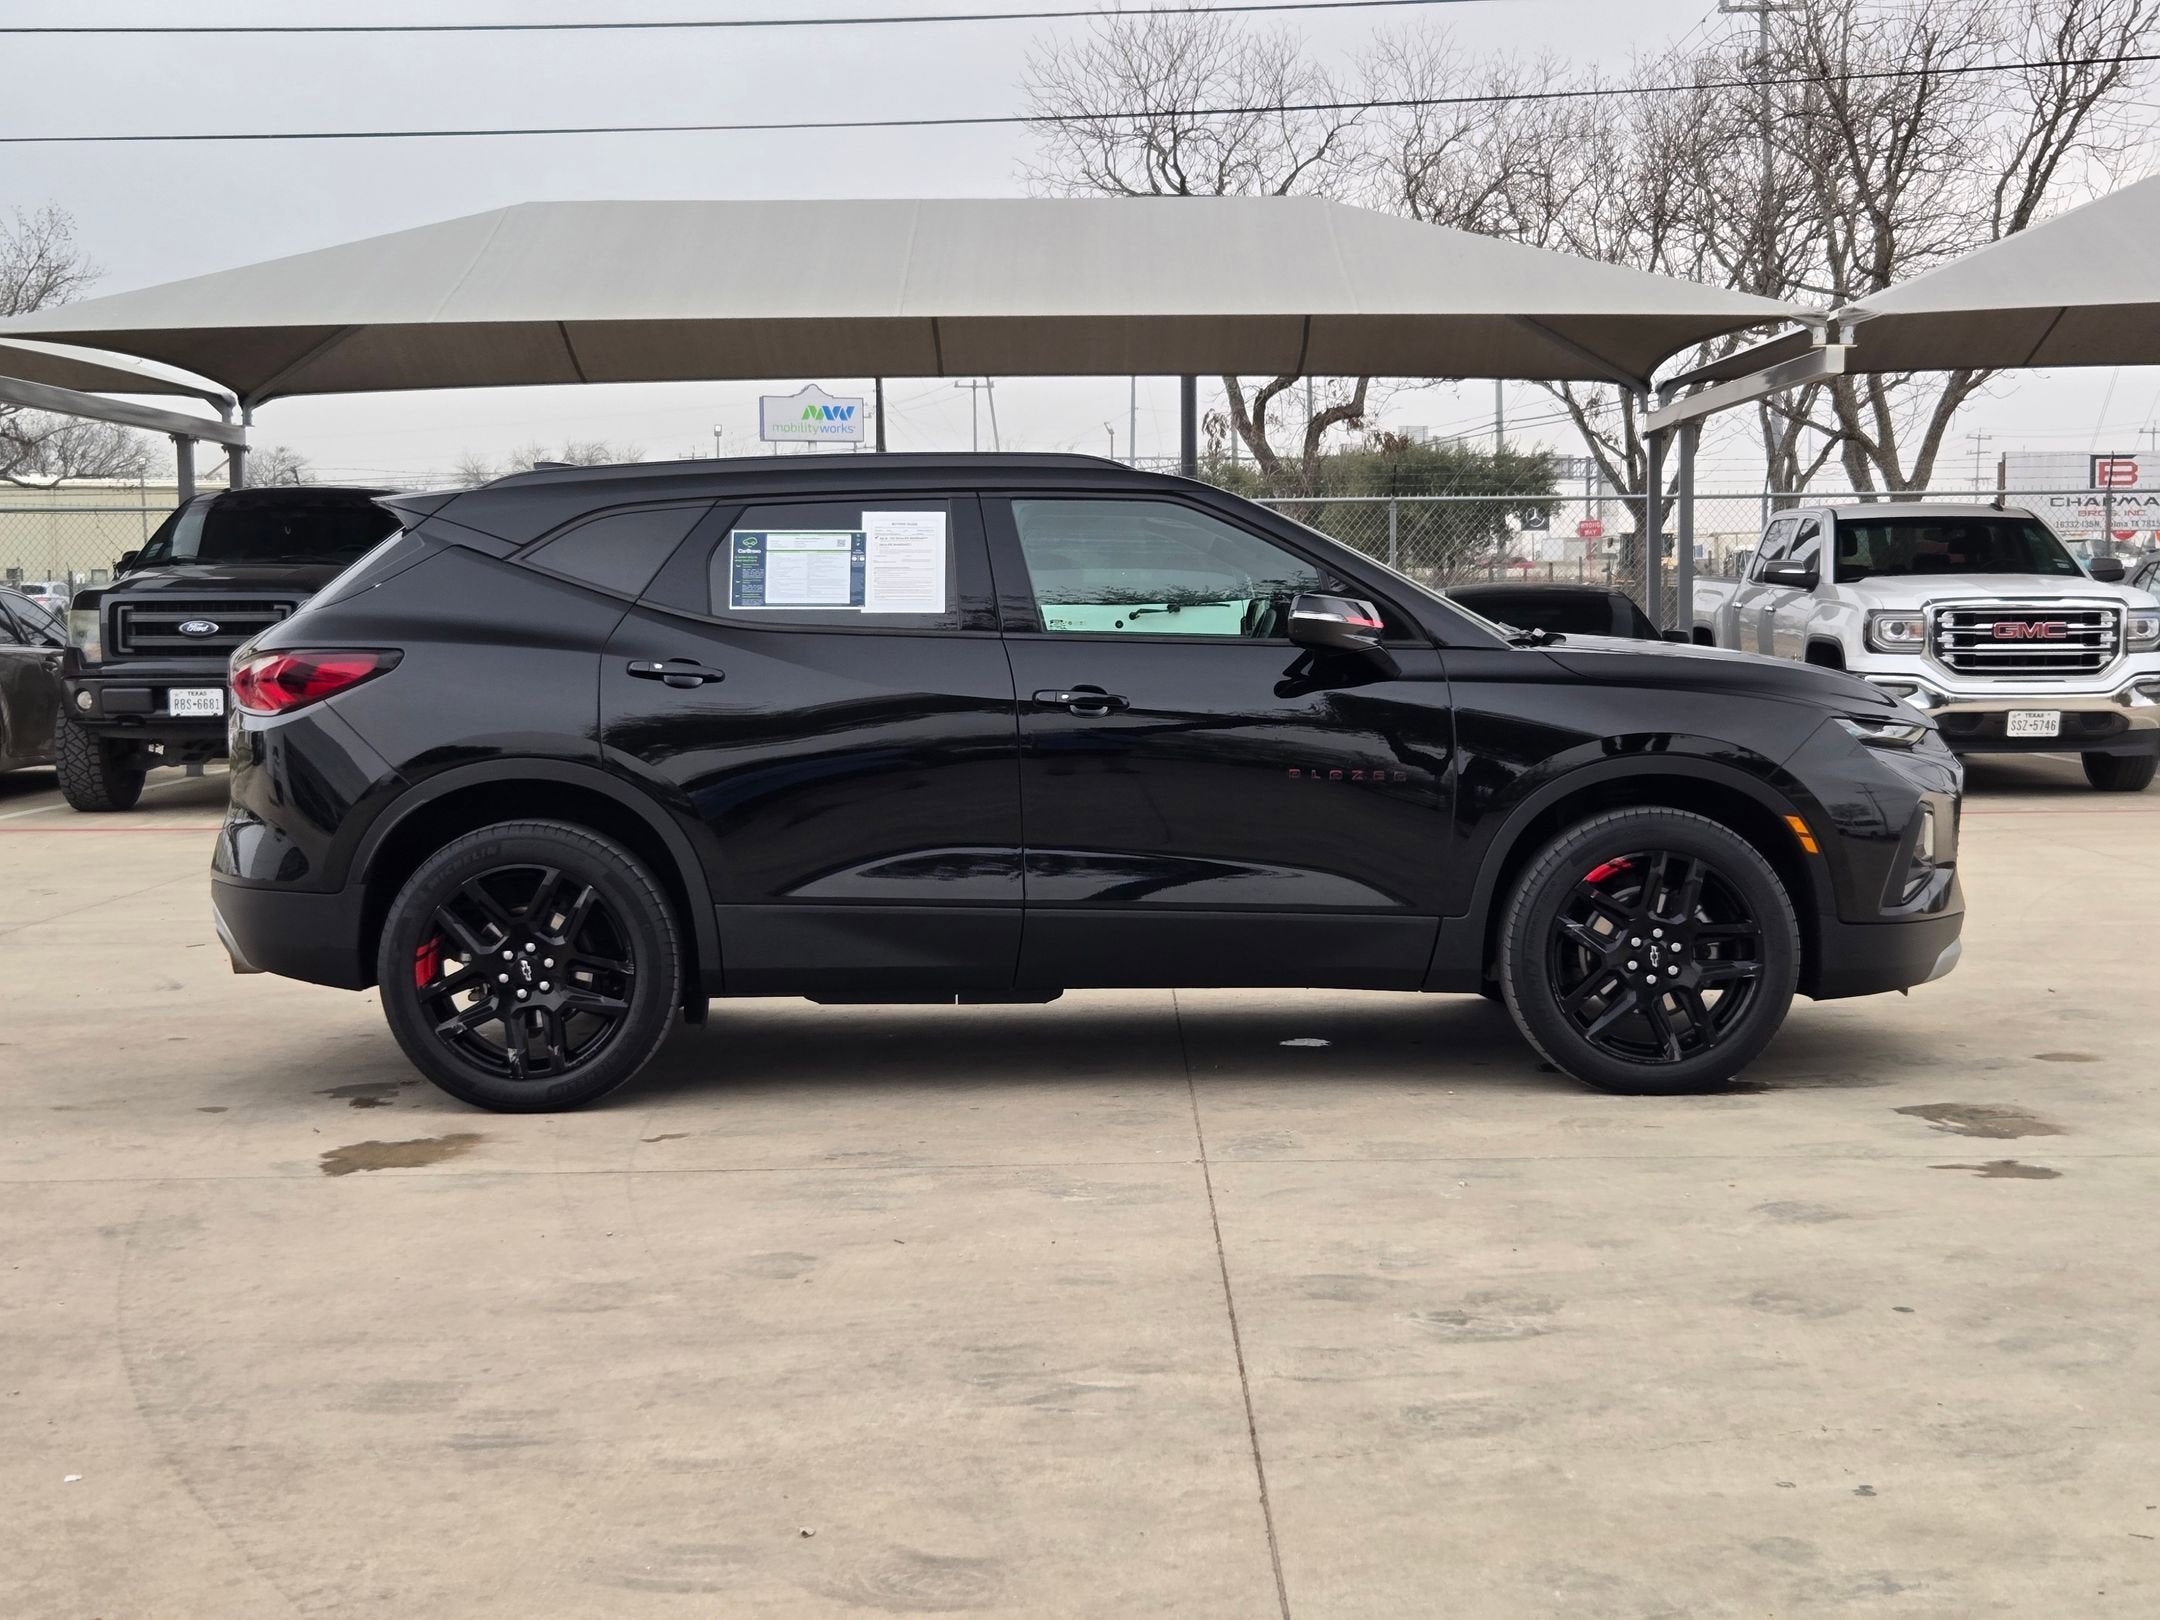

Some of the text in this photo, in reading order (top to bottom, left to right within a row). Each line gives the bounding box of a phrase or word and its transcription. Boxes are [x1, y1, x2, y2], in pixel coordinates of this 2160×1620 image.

[772, 422, 855, 434] mobilityworks
[187, 623, 209, 632] Ford
[1993, 621, 2067, 639] GMC
